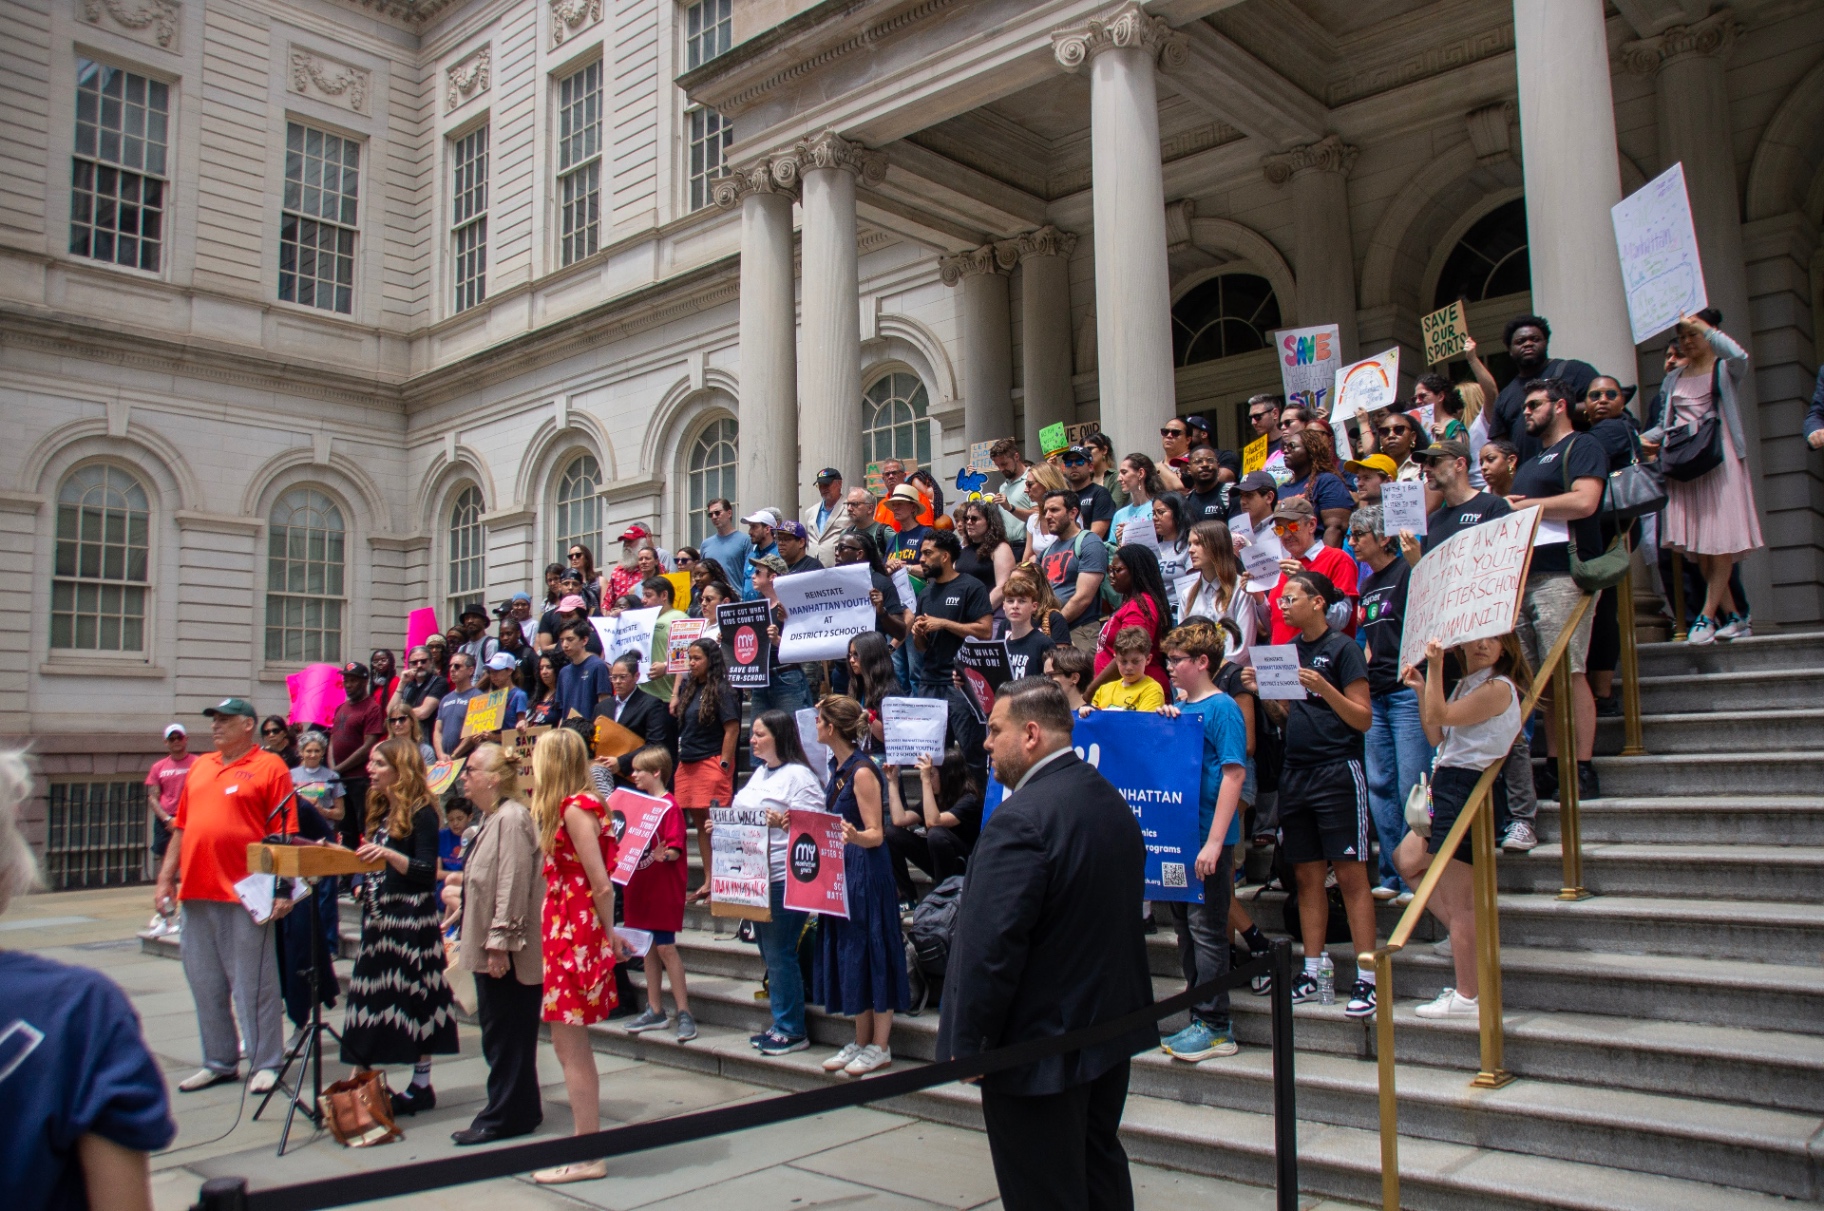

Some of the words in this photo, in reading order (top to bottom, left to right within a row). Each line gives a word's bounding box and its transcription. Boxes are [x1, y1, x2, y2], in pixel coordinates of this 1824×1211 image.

[1423, 303, 1458, 333] SAVE
[1432, 324, 1455, 343] OUR
[1283, 332, 1332, 366] SAVE
[1428, 331, 1467, 362] SPORTS
[1439, 536, 1469, 566] TAKE
[1473, 516, 1526, 548] AWAY
[1473, 544, 1527, 572] YOUTH
[805, 587, 845, 599] REINSTATE
[1440, 573, 1521, 612] AFTERSCHOOL
[721, 609, 736, 617] DON'T
[749, 606, 765, 614] WHAT
[789, 601, 840, 615] MANHATTAN
[842, 597, 871, 609] YOUTH
[1381, 602, 1388, 613] 7
[723, 617, 736, 625] KIDS
[737, 615, 755, 624] COUNT
[756, 614, 766, 622] ON!
[824, 616, 833, 624] AT
[1433, 599, 1512, 643] COMMUNITY
[790, 631, 822, 641] DISTRICT
[974, 649, 1000, 657] WHAT
[985, 658, 1000, 667] ON!
[729, 666, 746, 674] SAVE
[465, 708, 498, 726] SPORTS
[1118, 787, 1183, 805] NHATTAN
[1142, 828, 1158, 838] nics
[795, 844, 816, 861] MY
[821, 849, 837, 858] AFTER
[1146, 844, 1182, 854] rograms
